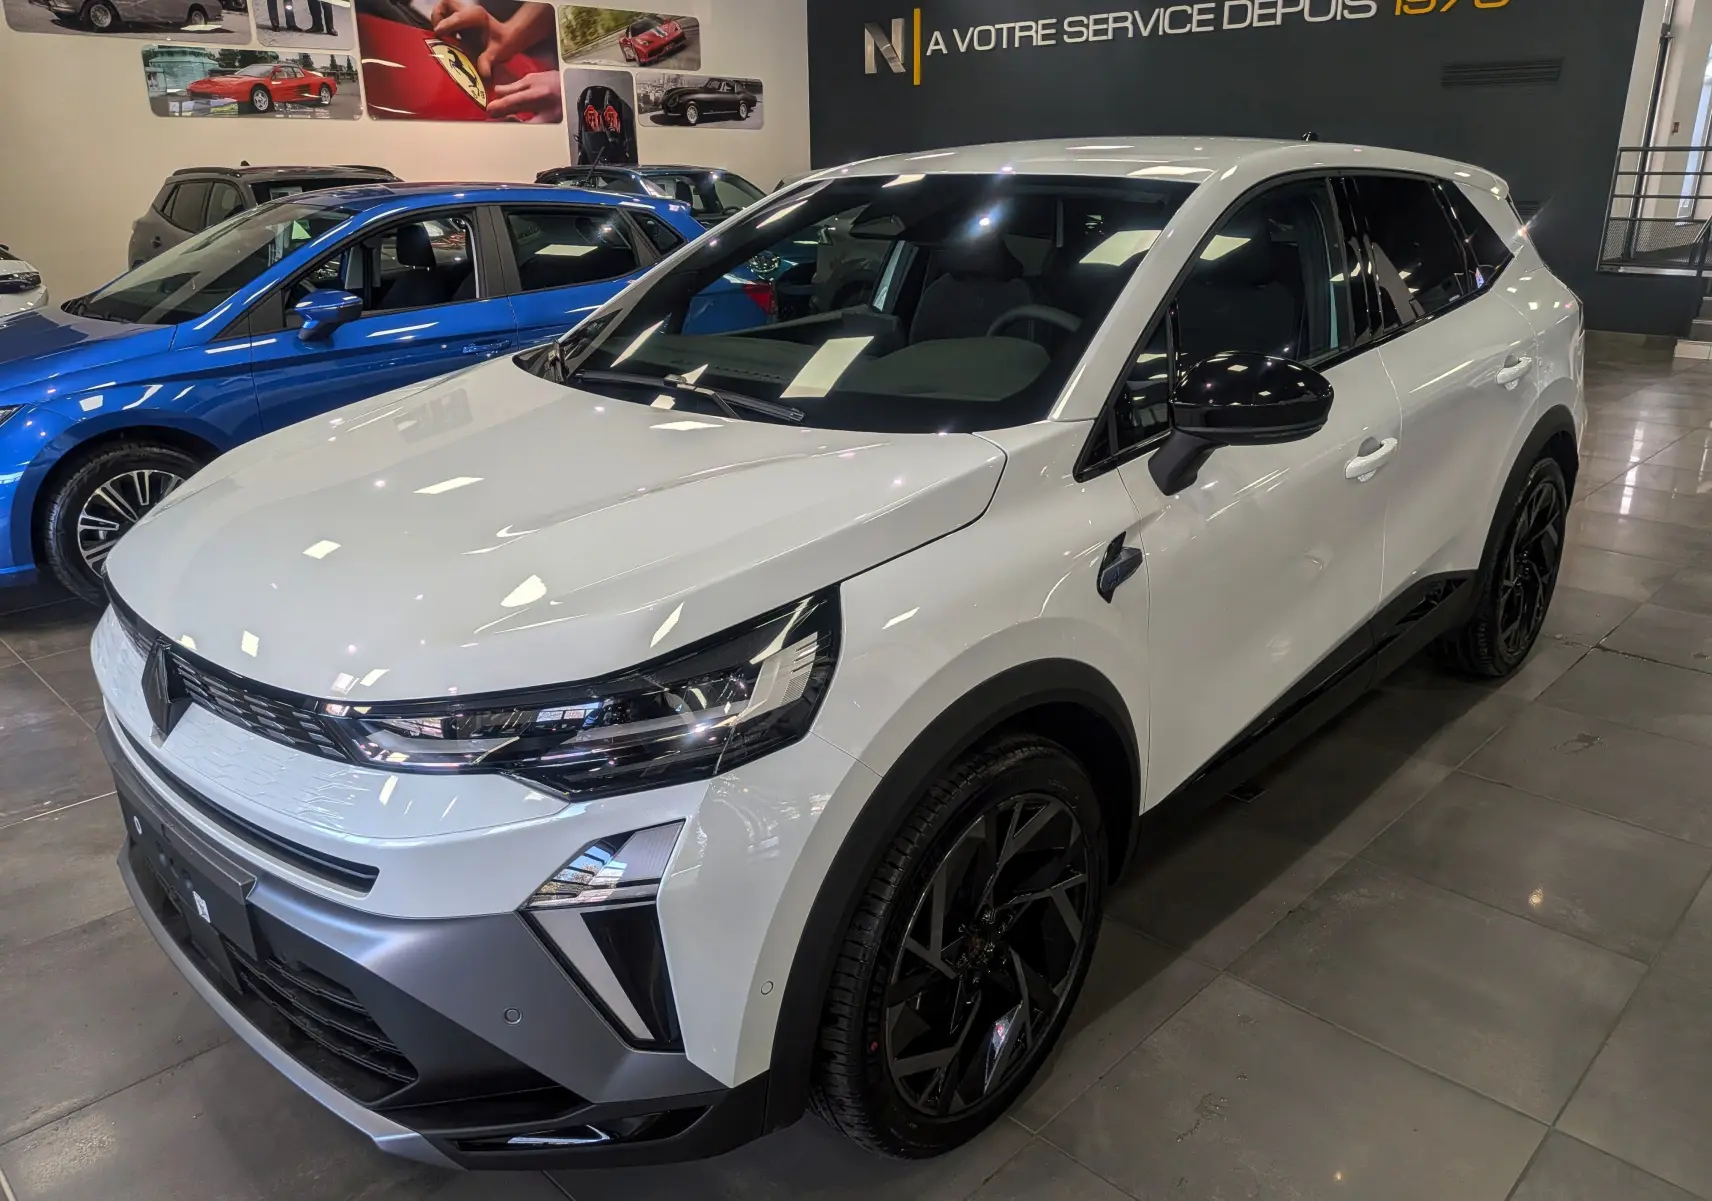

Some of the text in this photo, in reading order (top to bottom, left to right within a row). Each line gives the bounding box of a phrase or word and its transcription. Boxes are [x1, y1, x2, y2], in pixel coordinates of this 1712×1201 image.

[926, 30, 948, 56] A
[952, 18, 1057, 53] VOTRE
[1063, 2, 1216, 43] SERVICE
[1222, 0, 1377, 30] DEPUIS
